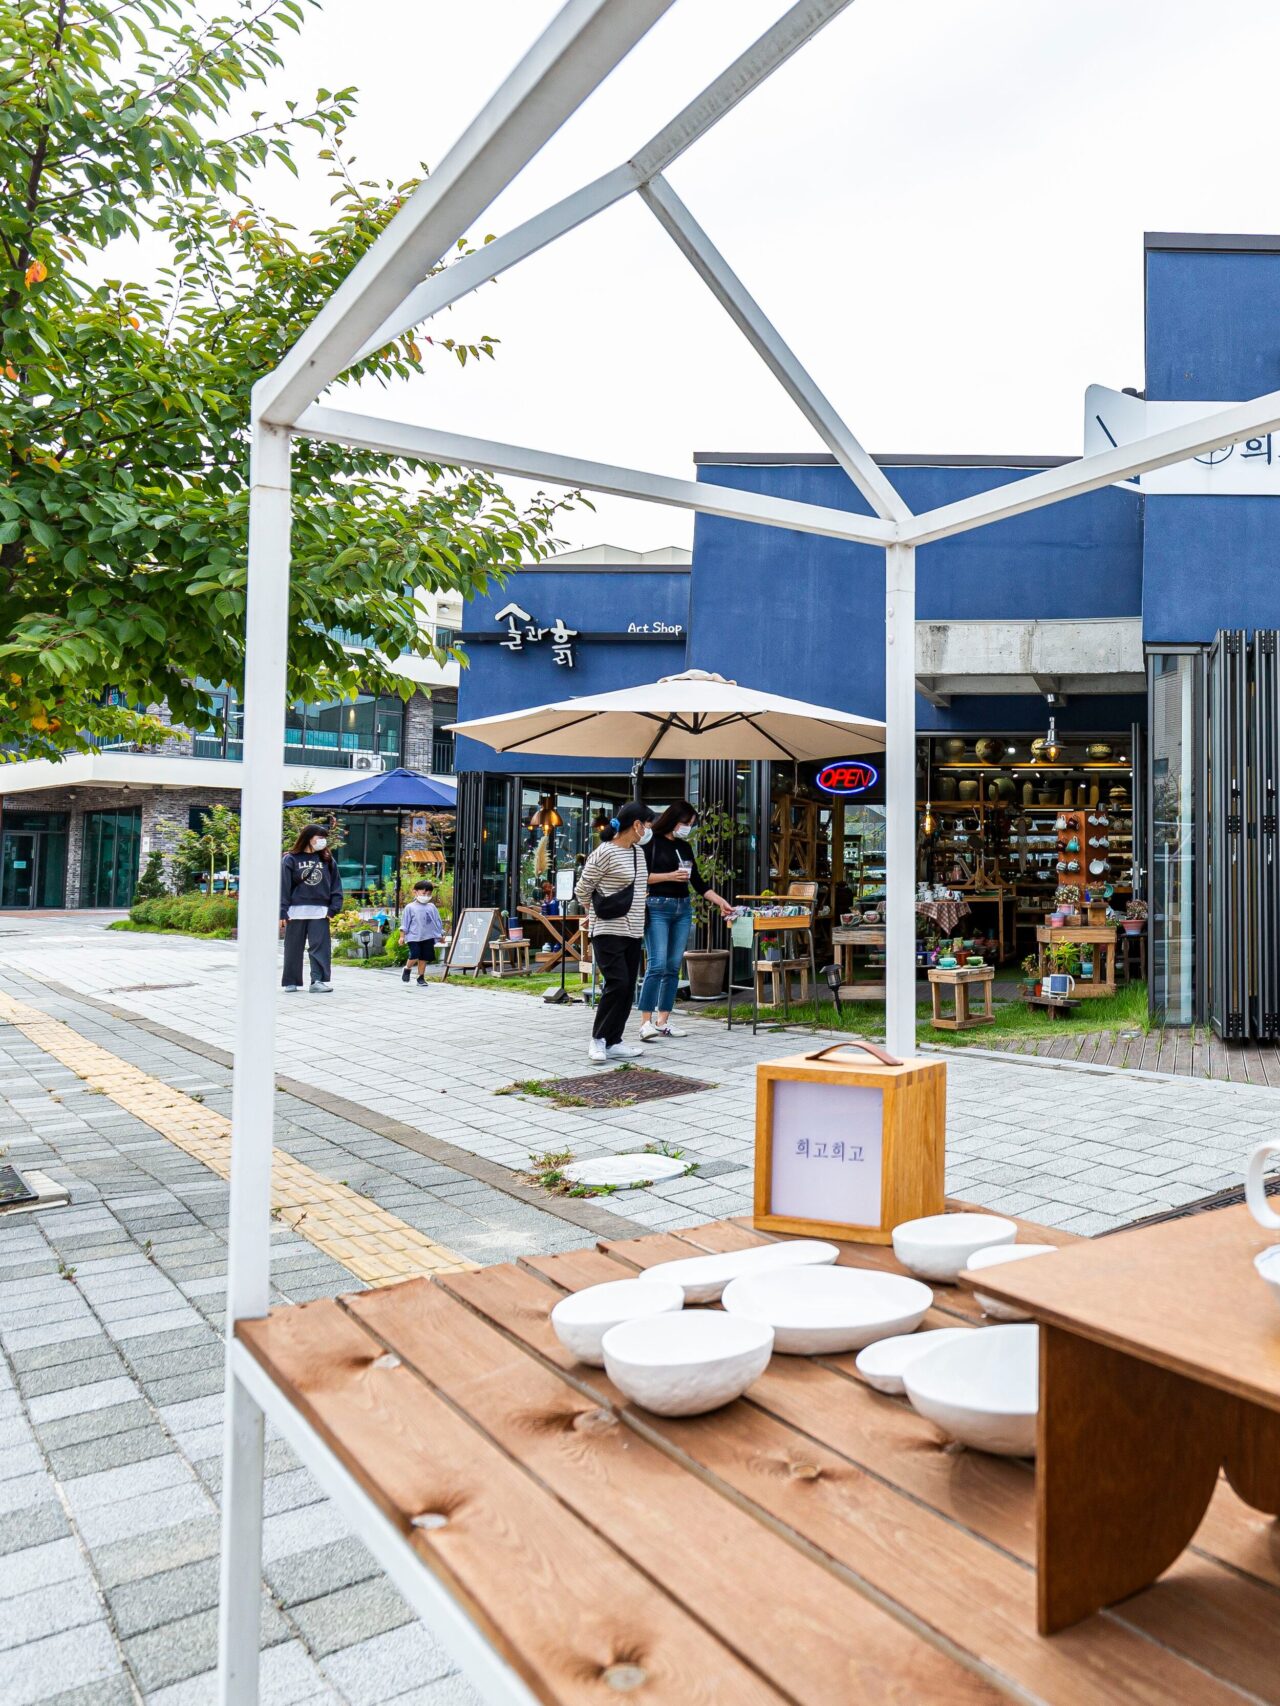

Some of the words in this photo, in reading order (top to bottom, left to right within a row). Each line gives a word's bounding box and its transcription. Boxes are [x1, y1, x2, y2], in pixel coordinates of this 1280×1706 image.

[494, 602, 577, 667] 솔과흙
[627, 622, 649, 633] Art
[652, 621, 682, 637] Shop
[820, 768, 872, 788] OPEN
[795, 1137, 865, 1163] 희고희고
